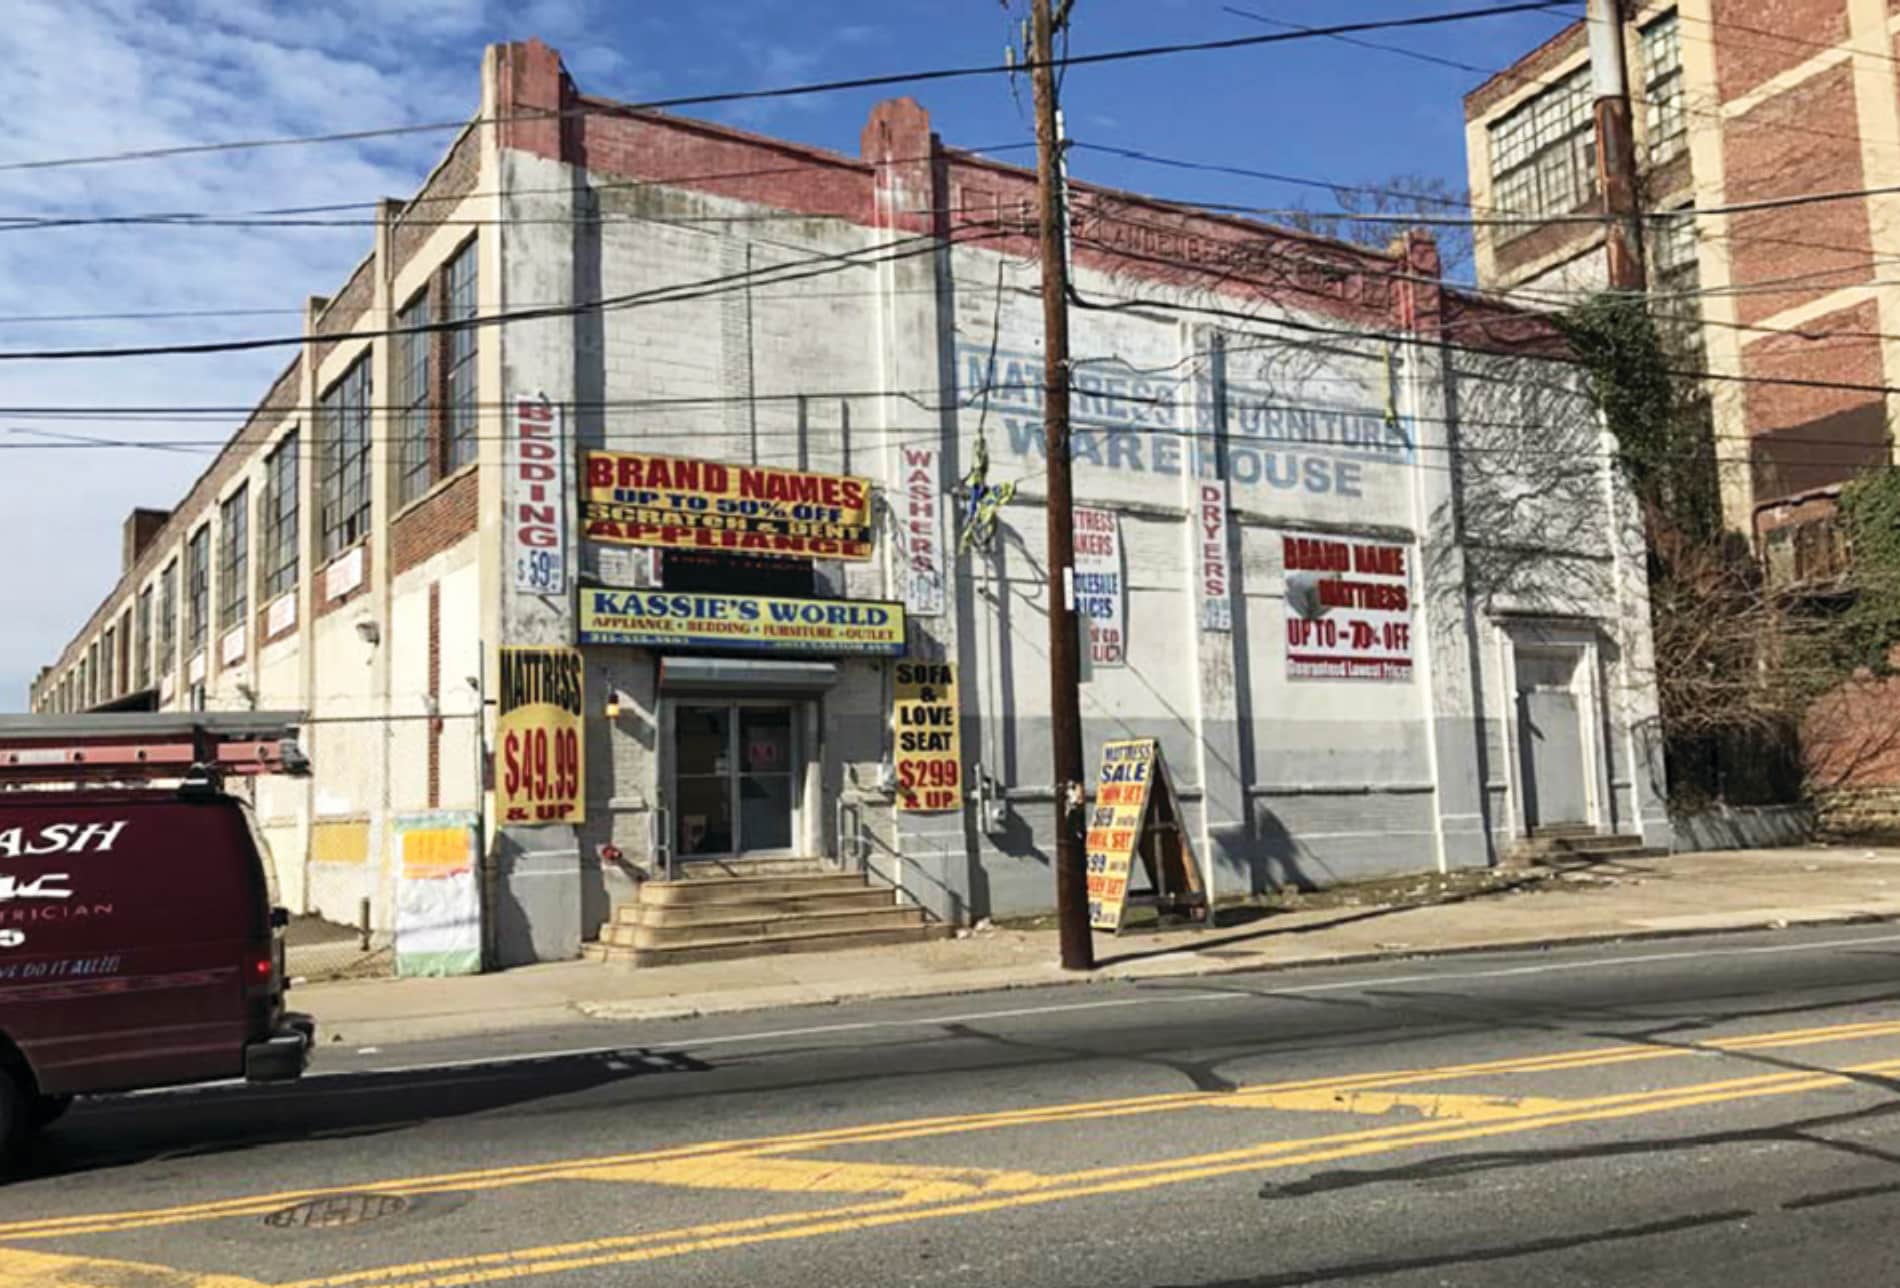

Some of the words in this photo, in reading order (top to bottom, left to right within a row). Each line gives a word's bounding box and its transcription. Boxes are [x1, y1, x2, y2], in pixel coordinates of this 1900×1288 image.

[518, 401, 557, 548] BEDDING
[588, 456, 728, 494] BRAND
[740, 467, 863, 510] NAMES
[614, 489, 658, 503] UP
[666, 492, 707, 511] TO
[717, 498, 785, 517] 50%
[792, 503, 843, 523] OFF
[906, 449, 933, 572] WASHERS
[586, 520, 868, 557] APPLIANCE
[1202, 486, 1224, 596] DRYERS
[1284, 537, 1350, 572] BRAND
[1354, 544, 1406, 576] NAME
[593, 591, 760, 621] KASSIE'S
[769, 600, 888, 626] WORLD
[593, 617, 674, 631] APPLIANCE
[687, 621, 749, 634] BEDDING
[763, 624, 833, 639] FURNITURE
[845, 627, 894, 640] OUTLET
[1288, 618, 1310, 647] UP
[1316, 619, 1336, 647] TO
[1384, 622, 1409, 650] OFF
[500, 650, 582, 716] MATTRESS
[897, 664, 952, 684] SOFA
[920, 687, 937, 702] &
[901, 706, 953, 726] LOVE
[901, 732, 952, 751] SEAT
[504, 727, 579, 802] $49.99
[899, 760, 958, 789] $299
[1102, 763, 1146, 783] SALE
[507, 808, 530, 821] &
[536, 803, 575, 821] UP
[925, 791, 954, 807] UP
